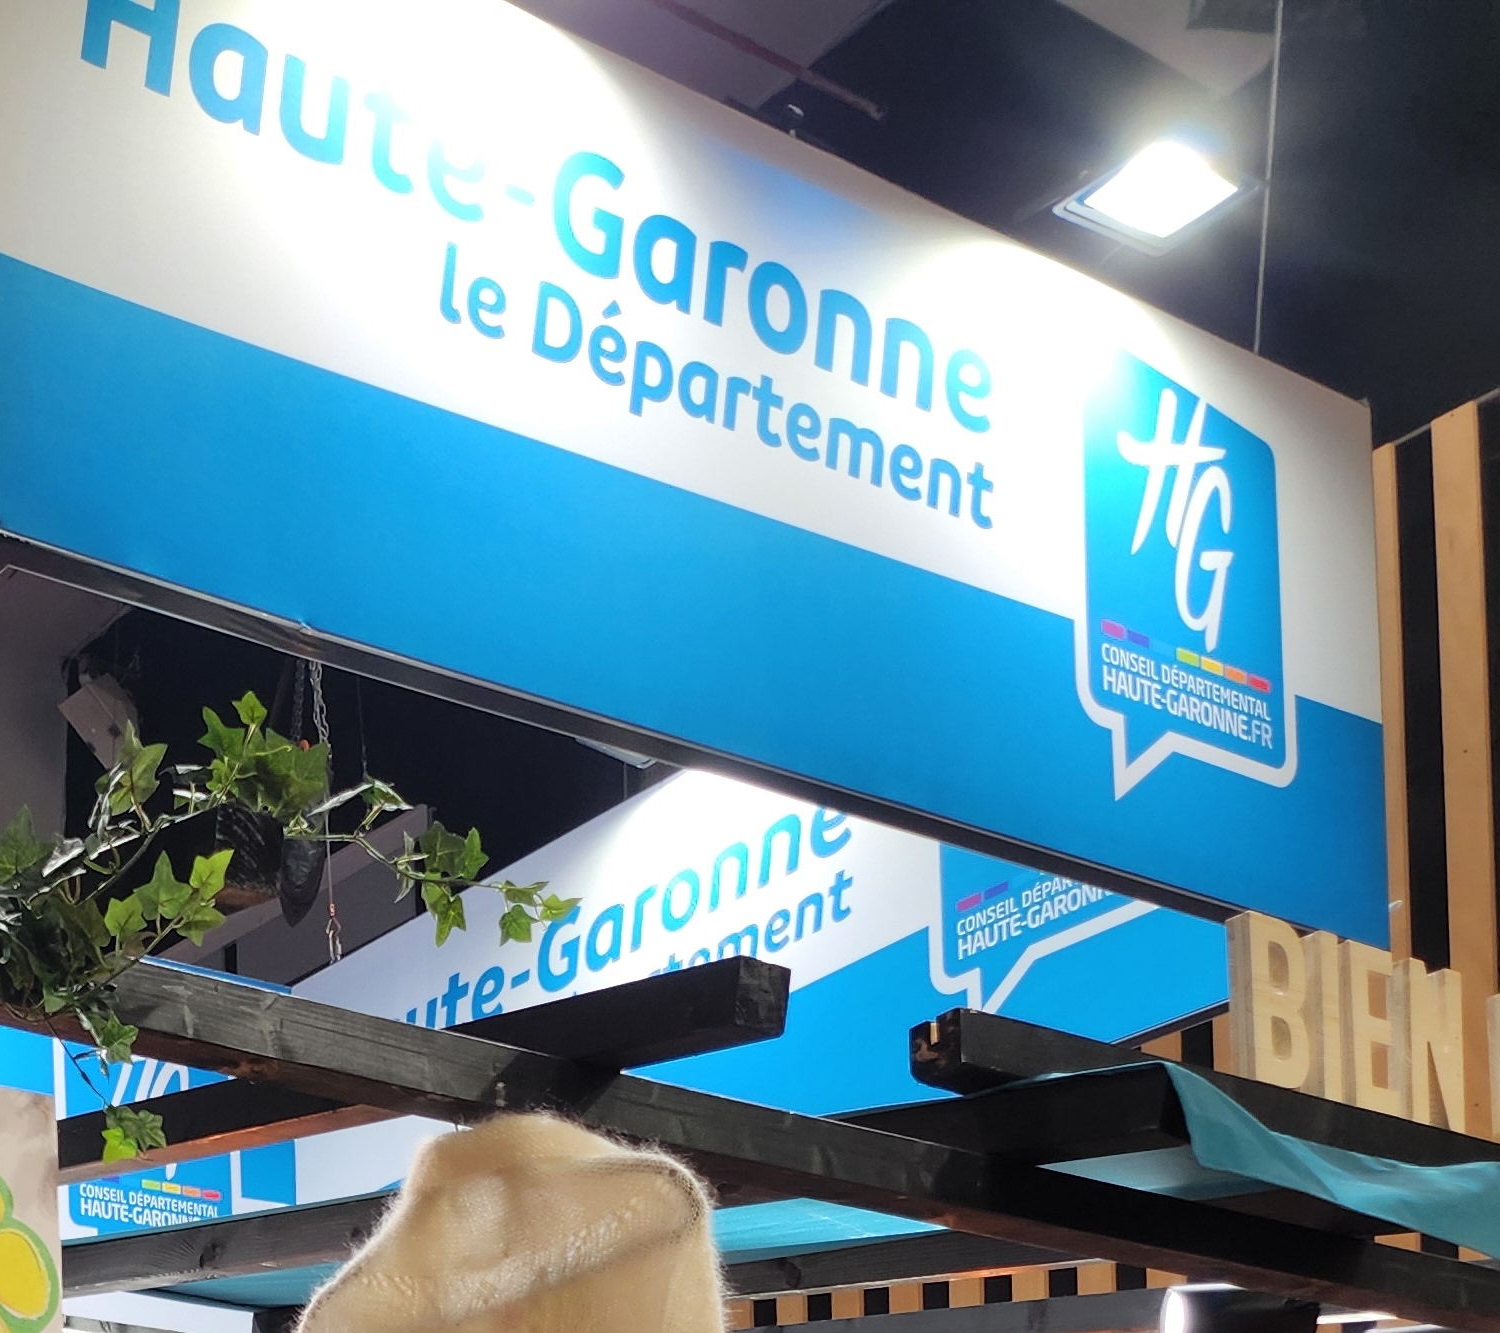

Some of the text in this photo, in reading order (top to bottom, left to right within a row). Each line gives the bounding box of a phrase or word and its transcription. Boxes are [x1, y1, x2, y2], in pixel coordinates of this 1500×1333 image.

[439, 242, 994, 531] le Département
[1102, 643, 1272, 721] CONSEIL DÉPARTEMENTAL
[1102, 664, 1274, 750] HAUTE-GARONNE.FR
[956, 896, 1019, 937] CONSEIL
[1228, 910, 1467, 1133] BIEN
[78, 1183, 220, 1219] CONSEIL DÉPARTEMENTAL
